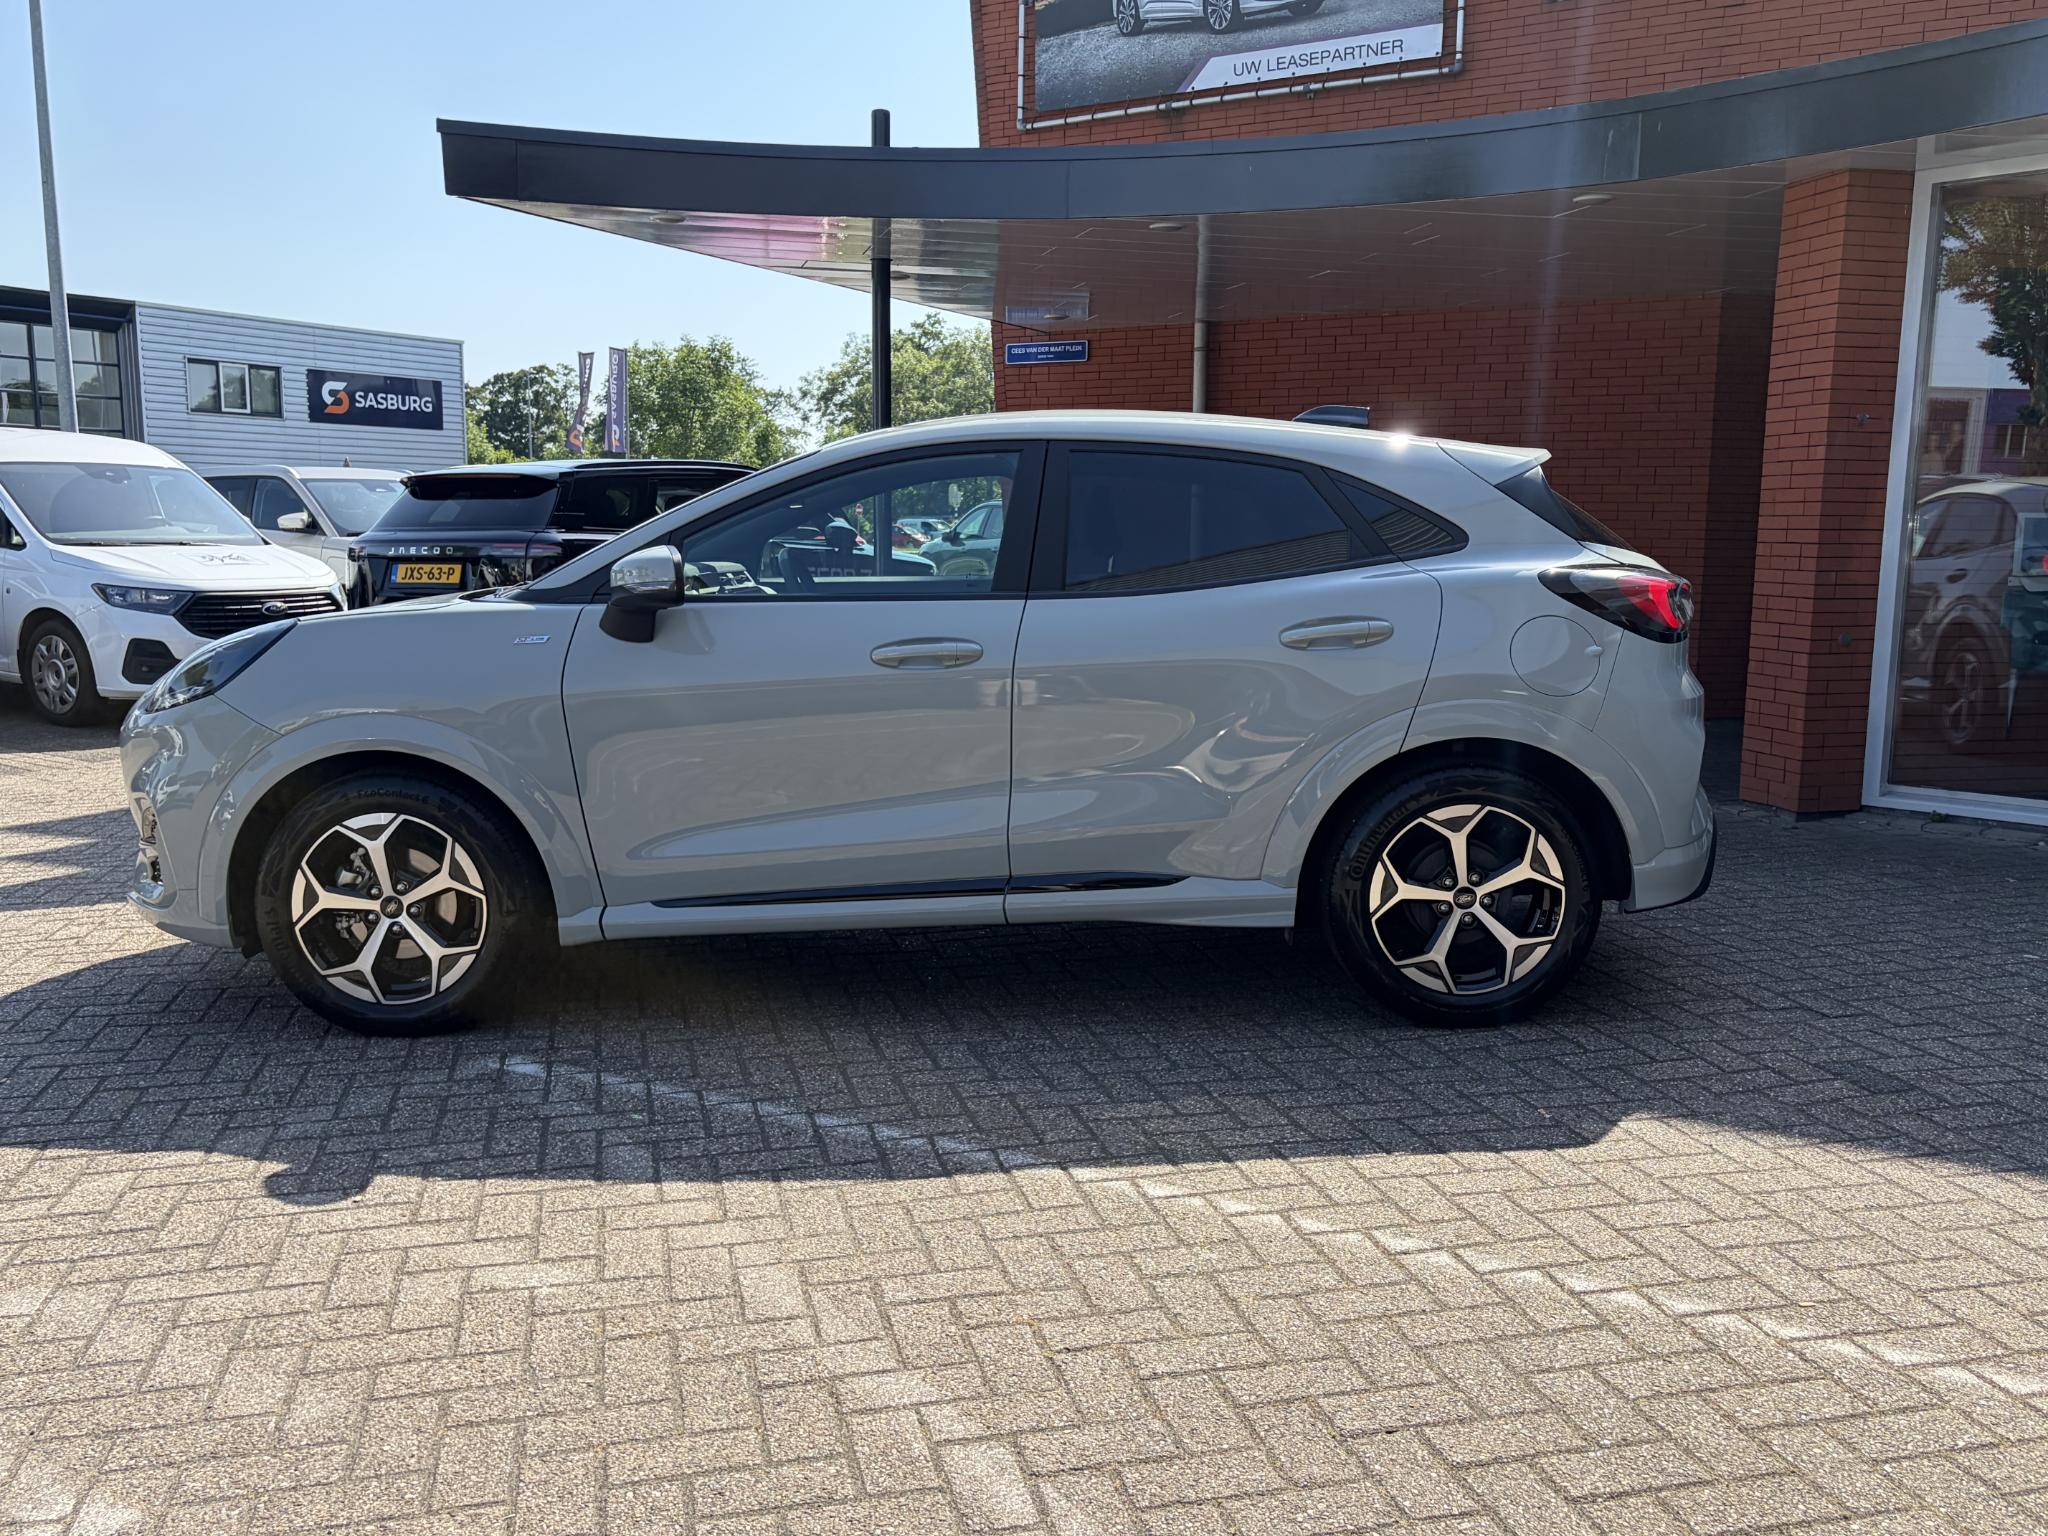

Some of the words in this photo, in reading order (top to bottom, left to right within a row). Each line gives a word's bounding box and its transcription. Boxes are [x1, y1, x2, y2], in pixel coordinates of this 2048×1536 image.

[1233, 59, 1262, 77] UW
[1266, 39, 1404, 72] LEASEPARTNER
[355, 391, 433, 413] SASBURG
[388, 546, 454, 555] JAECOO
[401, 566, 455, 581] JXS-63-P
